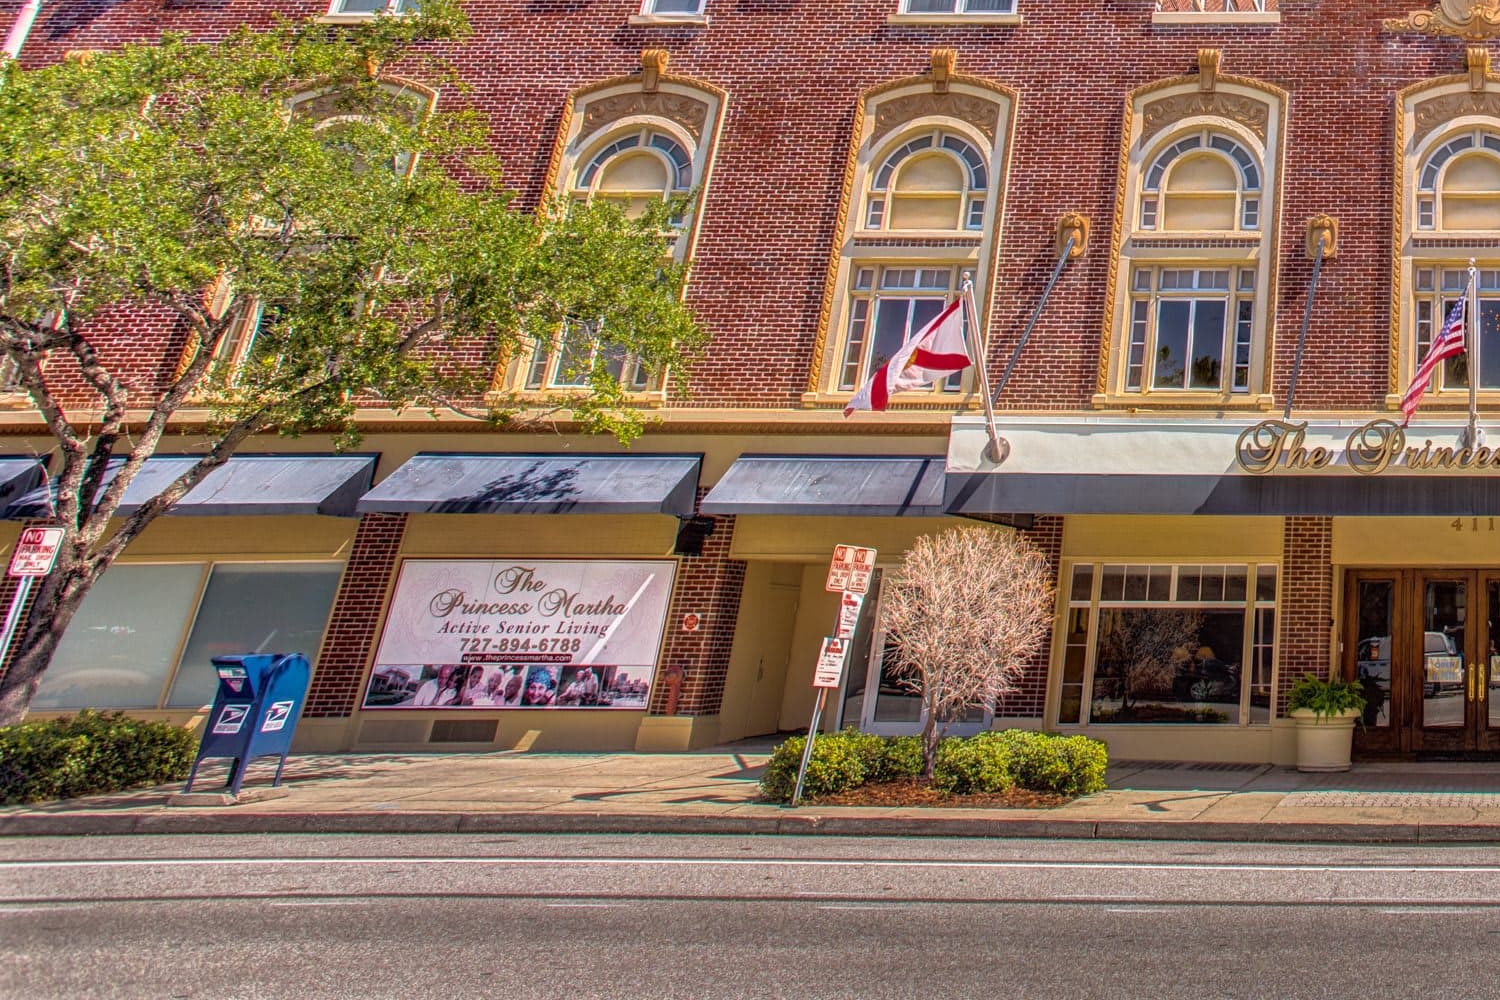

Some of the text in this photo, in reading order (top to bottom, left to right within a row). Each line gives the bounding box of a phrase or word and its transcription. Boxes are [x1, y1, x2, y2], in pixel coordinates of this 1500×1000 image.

[1235, 419, 1335, 474] The
[1451, 517, 1495, 531] 411
[24, 531, 45, 544] NO
[20, 545, 55, 553] PARKING
[494, 566, 547, 594] The
[429, 588, 629, 617] Princess Martha
[437, 621, 610, 638] Active Senior Living
[460, 638, 581, 652] 727-894-6788
